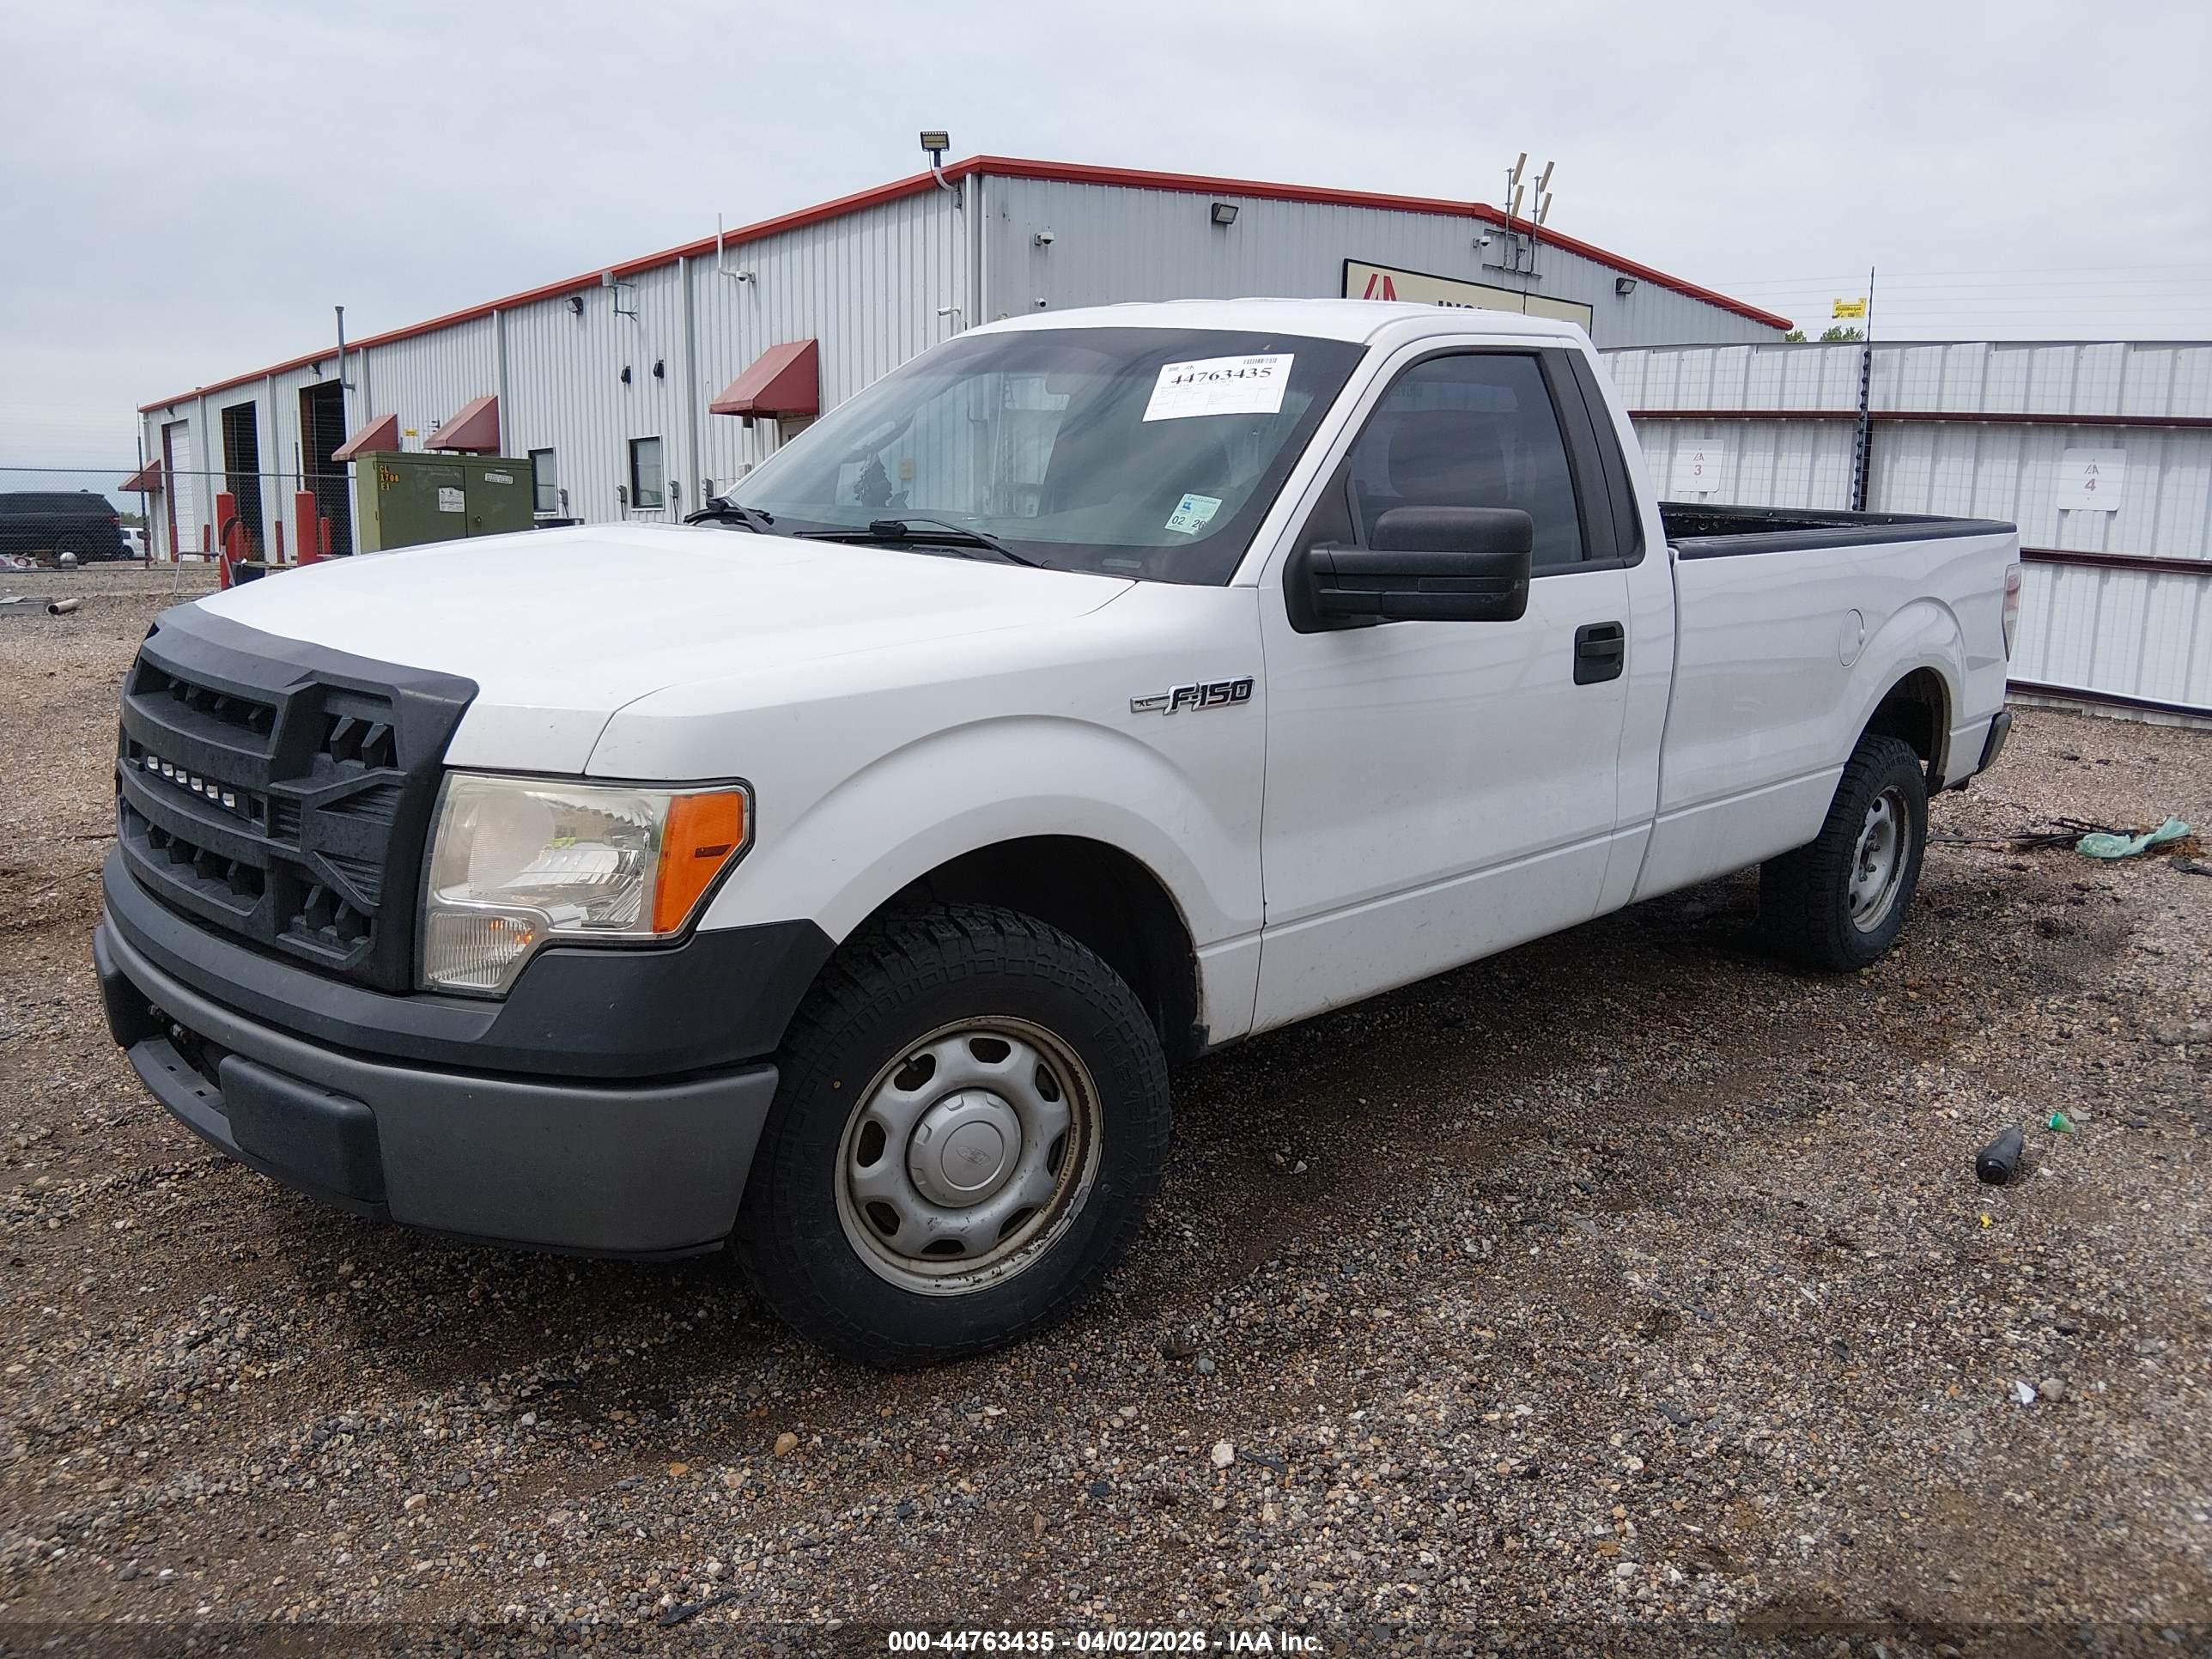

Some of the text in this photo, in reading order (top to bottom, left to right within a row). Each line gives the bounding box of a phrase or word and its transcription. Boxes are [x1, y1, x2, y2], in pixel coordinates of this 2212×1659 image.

[1171, 367, 1273, 385] 44763435
[1694, 465, 1702, 476] 3
[2084, 478, 2096, 491] 4
[1171, 515, 1186, 526] 02
